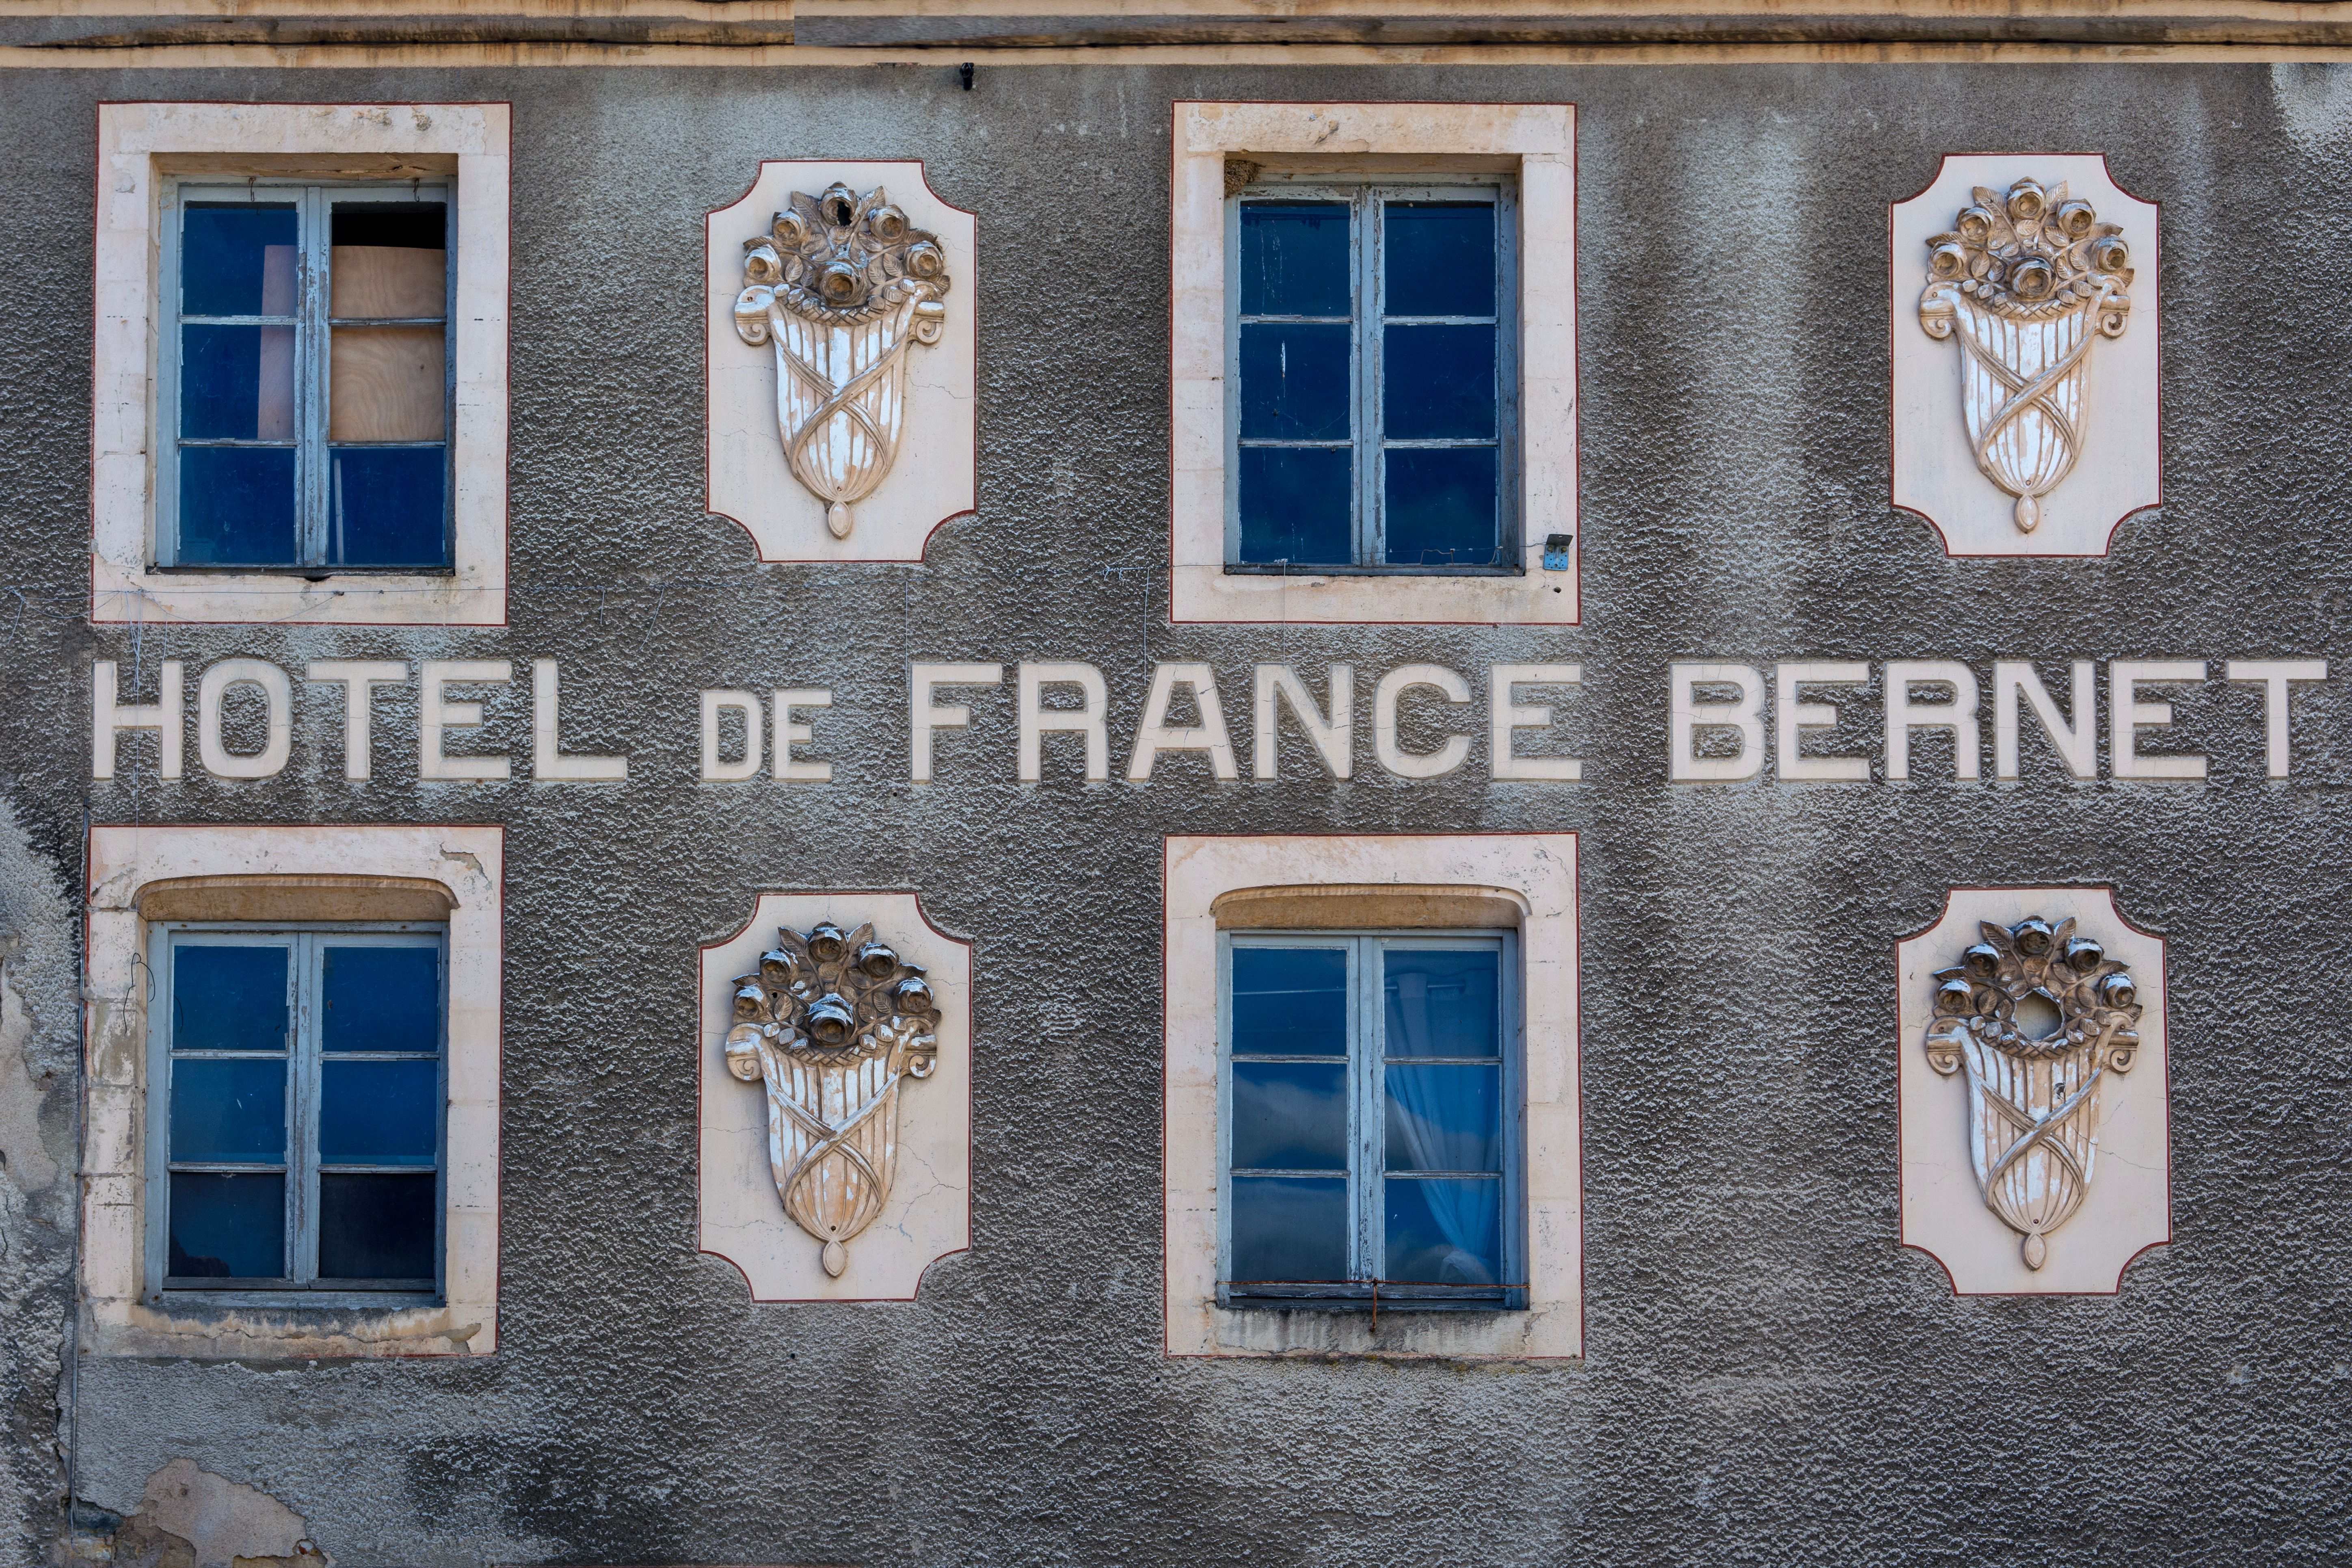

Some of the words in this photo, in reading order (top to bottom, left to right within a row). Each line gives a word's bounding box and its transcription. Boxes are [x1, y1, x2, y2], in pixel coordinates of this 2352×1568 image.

[93, 659, 627, 779] HOTEL
[700, 689, 832, 779] DE
[911, 661, 1581, 780] FRANCE
[1671, 661, 2327, 779] BERNET
